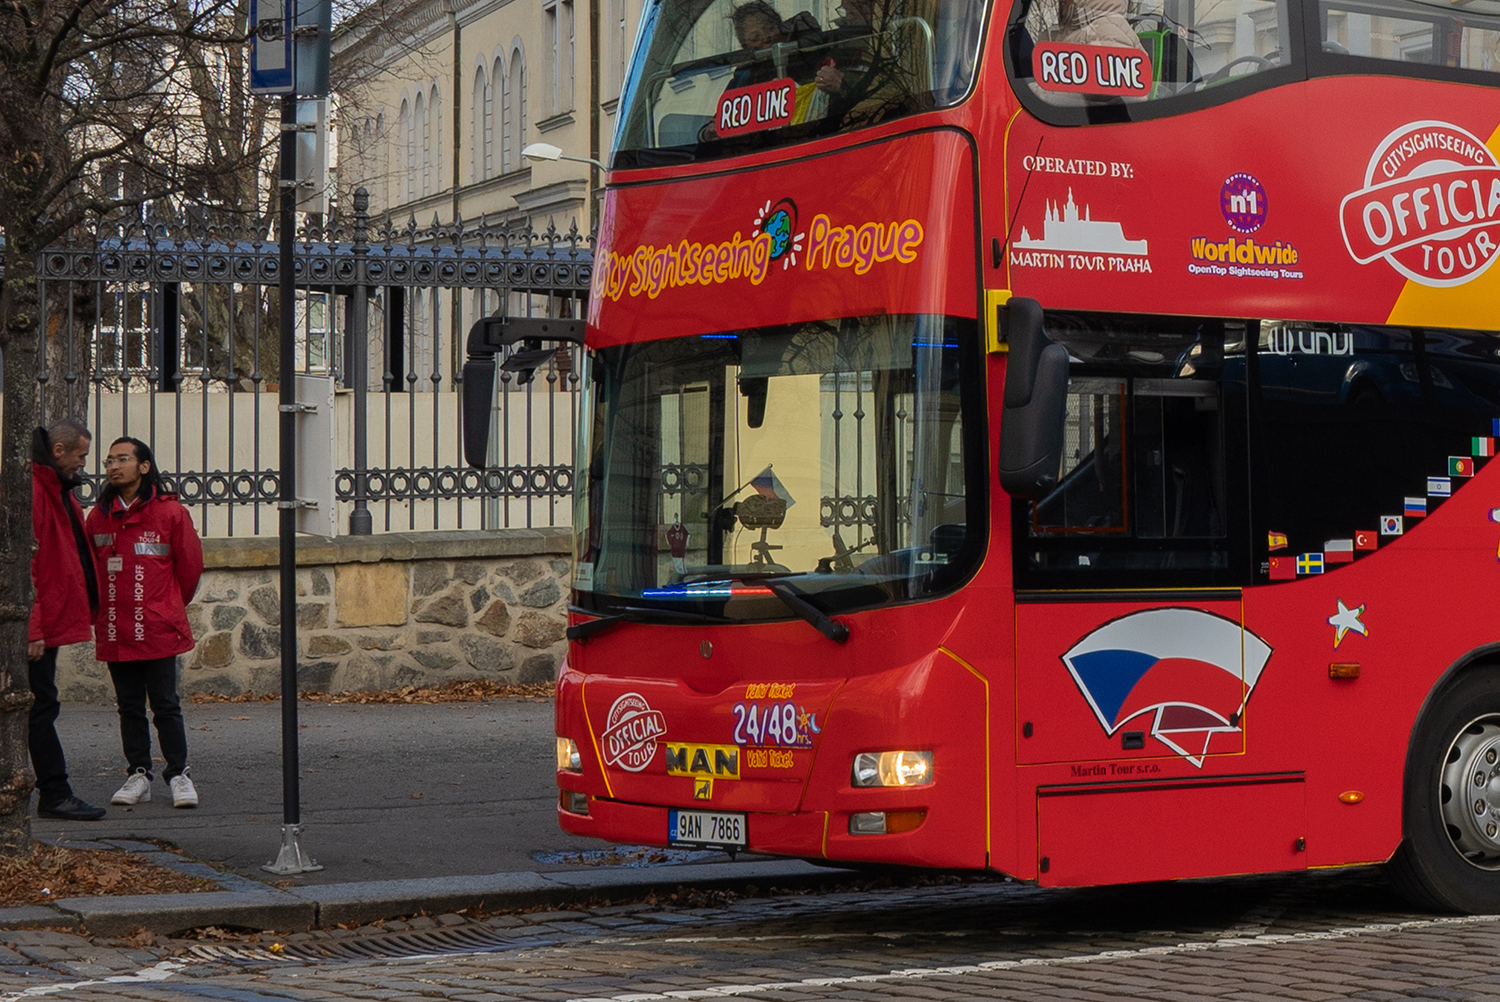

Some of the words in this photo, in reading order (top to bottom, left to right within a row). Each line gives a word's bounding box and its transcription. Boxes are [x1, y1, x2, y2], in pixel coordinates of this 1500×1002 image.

[1041, 50, 1089, 85] RED
[1095, 54, 1144, 89] LINE
[720, 101, 753, 130] RED
[756, 86, 790, 121] LINE
[1022, 155, 1107, 177] OPERATED
[1110, 163, 1134, 179] BY:
[1382, 133, 1484, 178] CITYSIGHTSEEING
[806, 214, 924, 276] Prague
[1191, 237, 1299, 265] Worldwide
[1421, 231, 1497, 275] TOUR
[1010, 251, 1064, 269] MARTIN
[1067, 254, 1105, 272] TOUR
[1108, 257, 1153, 274] PRAHA
[1188, 264, 1227, 276] OpenTop
[1228, 265, 1278, 279] Sightseeing
[1280, 270, 1304, 280] Tours
[134, 564, 145, 581] OFF
[108, 582, 117, 602] HOP
[134, 582, 144, 602] HOP
[108, 606, 117, 622] ON
[134, 606, 144, 622] ON
[108, 622, 117, 641] HOP
[134, 623, 145, 641] HOP
[609, 713, 663, 756] OFFICIAL
[734, 703, 797, 745] 24/48
[628, 742, 654, 766] TOUR
[666, 746, 739, 775] MAN
[1070, 764, 1107, 777] Martin
[1108, 763, 1135, 775] Tour
[1136, 763, 1161, 774] s.r.o.
[670, 828, 678, 837] CZ
[680, 814, 702, 839] 9AN
[711, 816, 740, 841] 7866
